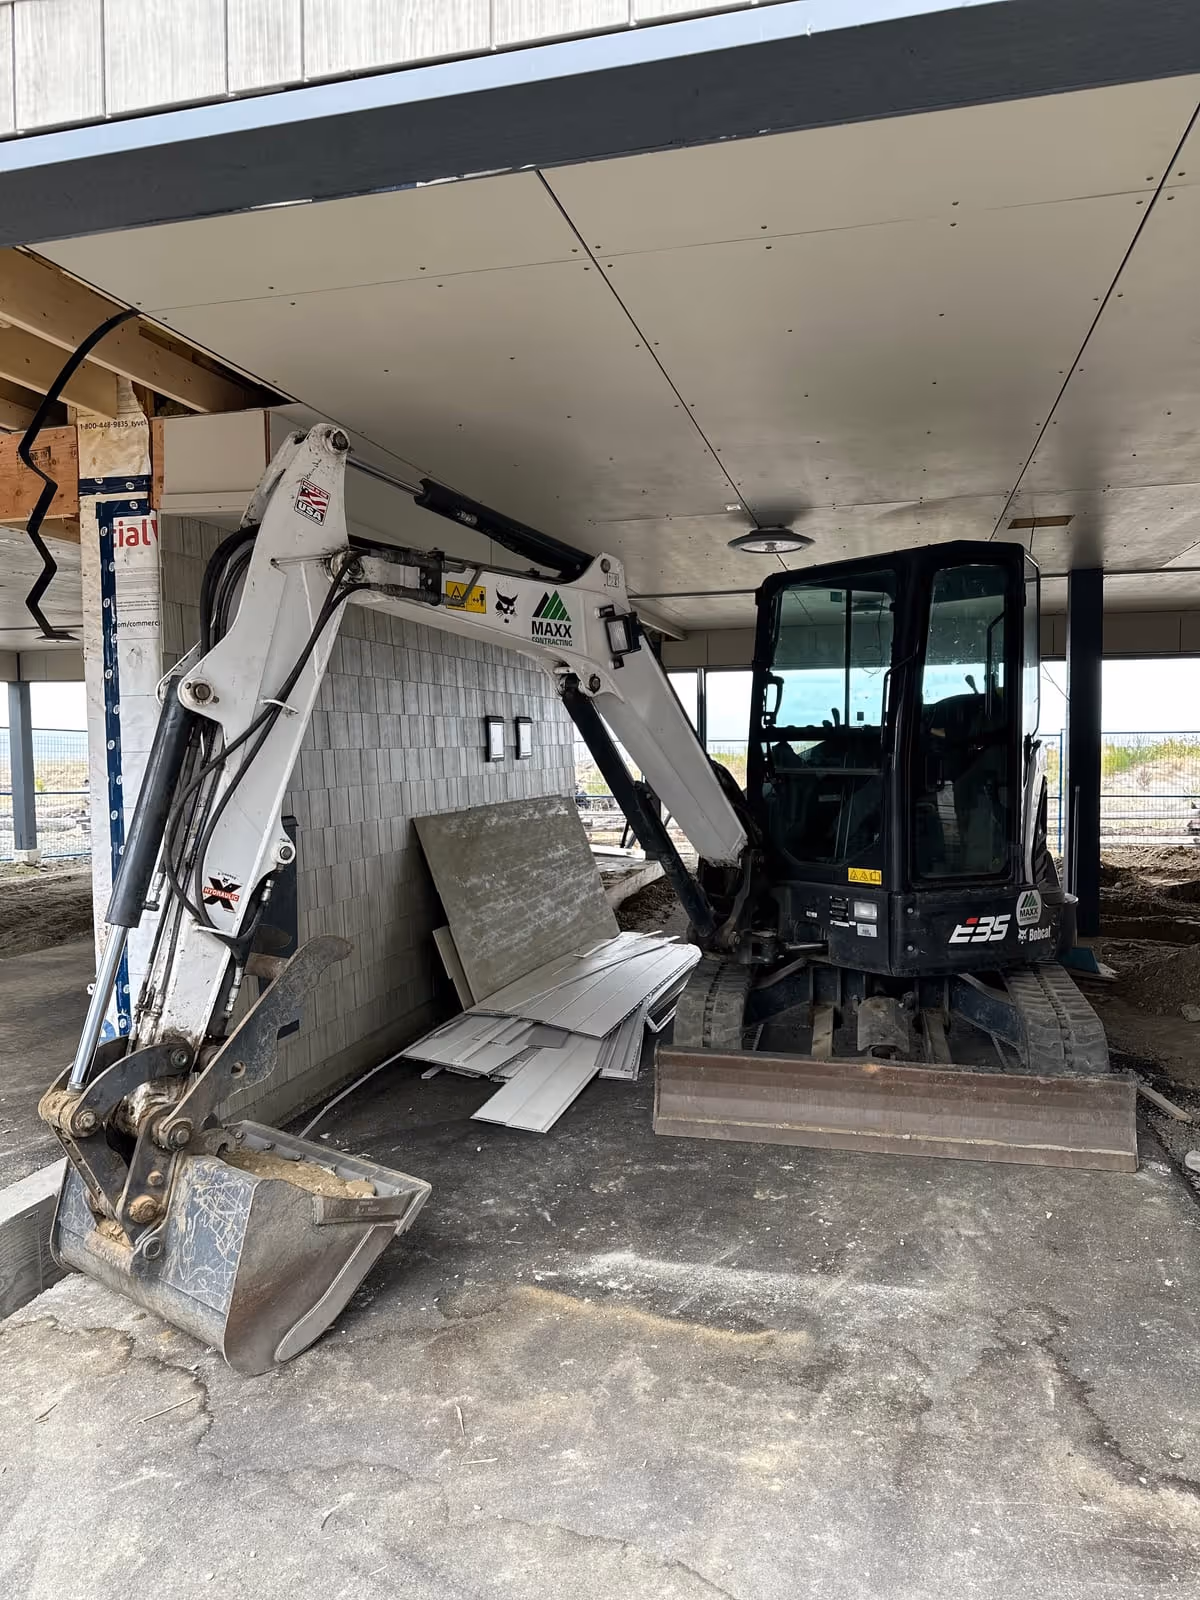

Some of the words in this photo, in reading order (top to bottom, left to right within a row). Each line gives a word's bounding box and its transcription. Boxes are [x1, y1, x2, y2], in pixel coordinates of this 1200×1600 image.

[297, 501, 323, 521] USA
[531, 620, 572, 639] MAXX
[531, 636, 573, 647] CONTRACTING
[203, 887, 240, 901] HYDRAULIC
[1019, 906, 1039, 918] MAXX
[948, 913, 1012, 944] E35
[1028, 925, 1052, 942] Bobcat
